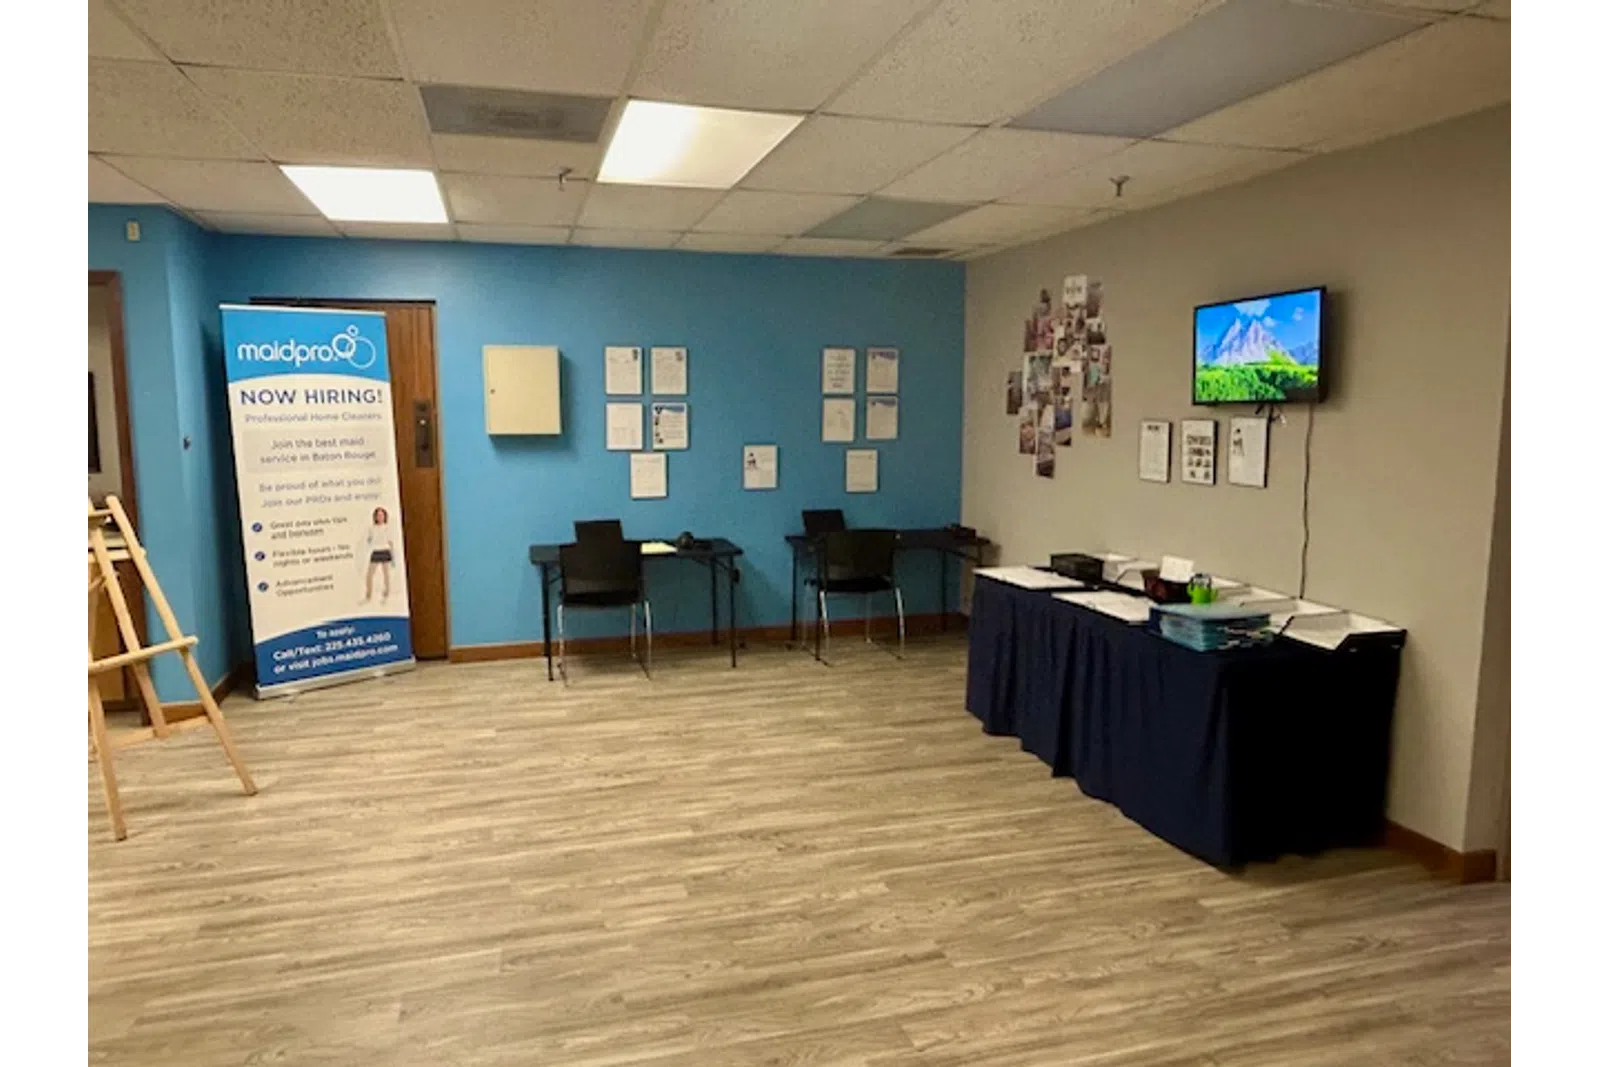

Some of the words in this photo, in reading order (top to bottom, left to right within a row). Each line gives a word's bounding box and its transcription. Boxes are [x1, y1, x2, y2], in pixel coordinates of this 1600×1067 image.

[240, 389, 297, 405] NOW
[303, 388, 383, 404] HIRING!
[244, 413, 307, 423] Professional
[310, 412, 339, 422] Home
[341, 412, 382, 421] Cleaners
[271, 441, 293, 450] Join
[295, 439, 312, 448] the
[315, 438, 337, 448] best
[339, 437, 364, 446] maid
[260, 454, 297, 464] service
[300, 453, 310, 462] in
[313, 452, 342, 462] Baton
[344, 450, 376, 460] Rouge
[259, 483, 272, 492] Be
[275, 481, 305, 493] proud
[308, 480, 319, 488] of
[322, 478, 344, 488] what
[347, 478, 364, 487] you
[262, 499, 283, 508] Join
[286, 498, 302, 506] our
[334, 494, 352, 502] and
[270, 521, 293, 530] Great
[271, 530, 287, 540] and
[272, 547, 306, 558] Flexible
[308, 545, 331, 554] hours
[273, 556, 300, 567] nights
[302, 556, 311, 564] or
[314, 552, 353, 562] weekends
[276, 574, 333, 588] Advancement
[276, 584, 334, 597] Opportunities
[316, 629, 327, 640] To
[273, 665, 285, 674] or
[288, 660, 310, 670] visit
